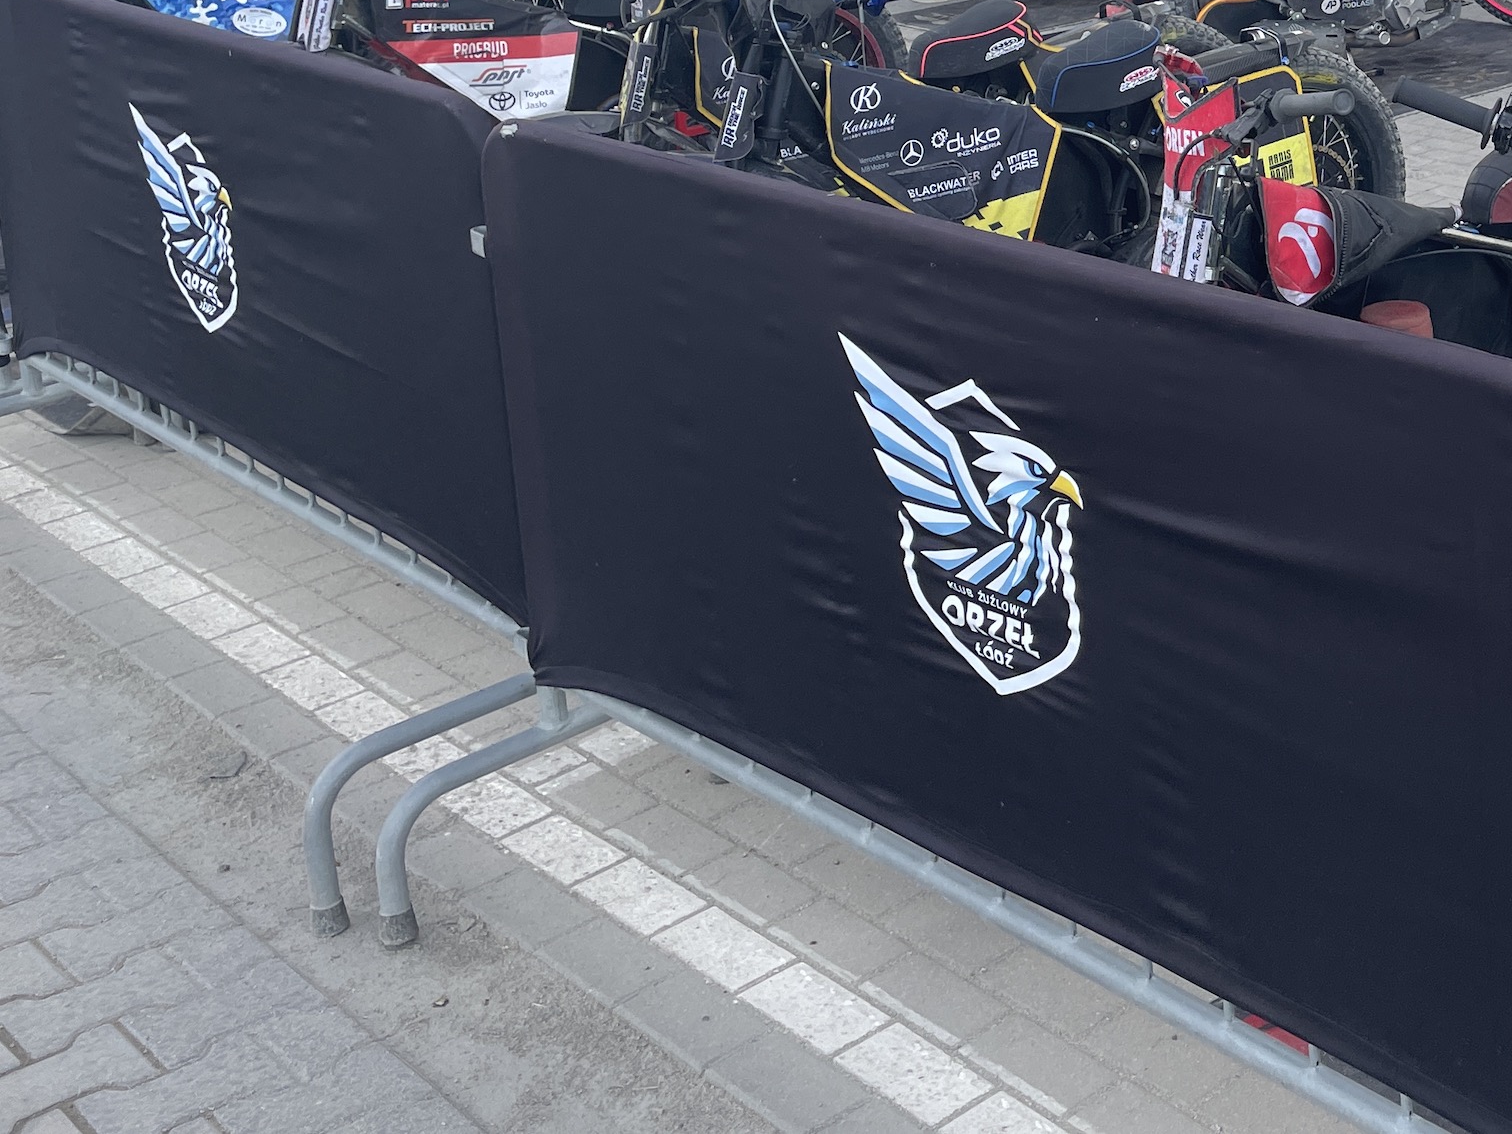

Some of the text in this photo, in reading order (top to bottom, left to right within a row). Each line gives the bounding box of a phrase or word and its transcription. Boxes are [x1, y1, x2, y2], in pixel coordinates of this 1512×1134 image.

[402, 19, 495, 34] TECH-PROJECT
[524, 89, 555, 99] Toyota
[842, 113, 896, 135] Kaliński
[946, 127, 1001, 153] duko
[1007, 149, 1038, 165] INTER
[1009, 159, 1039, 175] CARS
[907, 171, 981, 199] BLACKWATER
[946, 579, 1028, 619] KLUB ŻUŻLOWY
[941, 594, 1041, 660] ORZEŁ
[975, 639, 1014, 670] ŁÓDŹ
